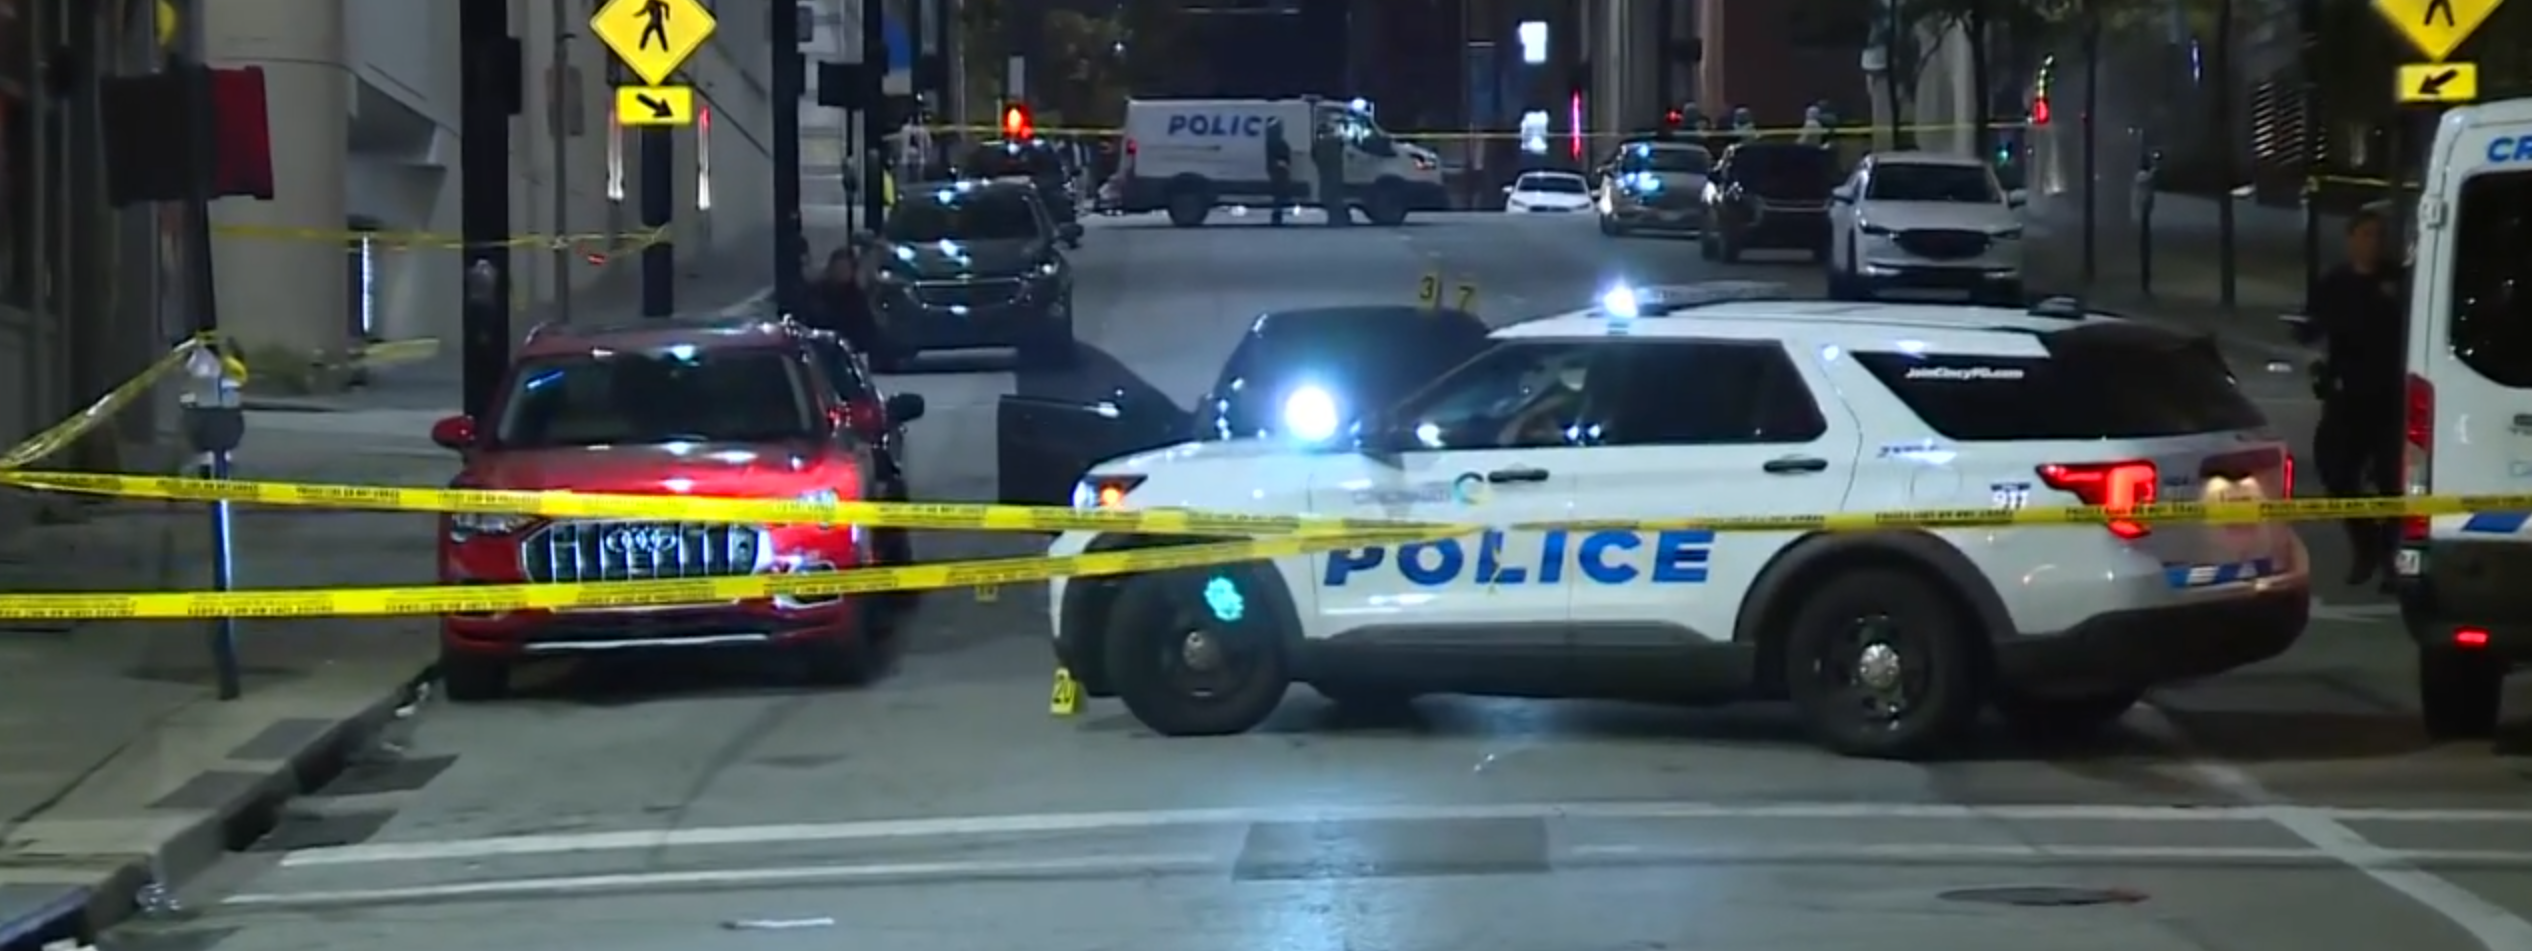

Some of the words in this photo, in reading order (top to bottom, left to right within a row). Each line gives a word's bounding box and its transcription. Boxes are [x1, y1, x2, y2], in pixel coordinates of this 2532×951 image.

[1168, 115, 1263, 136] POLIC
[1419, 275, 1435, 299] 3
[1458, 286, 1476, 311] 7
[1323, 529, 1715, 586] POLICE
